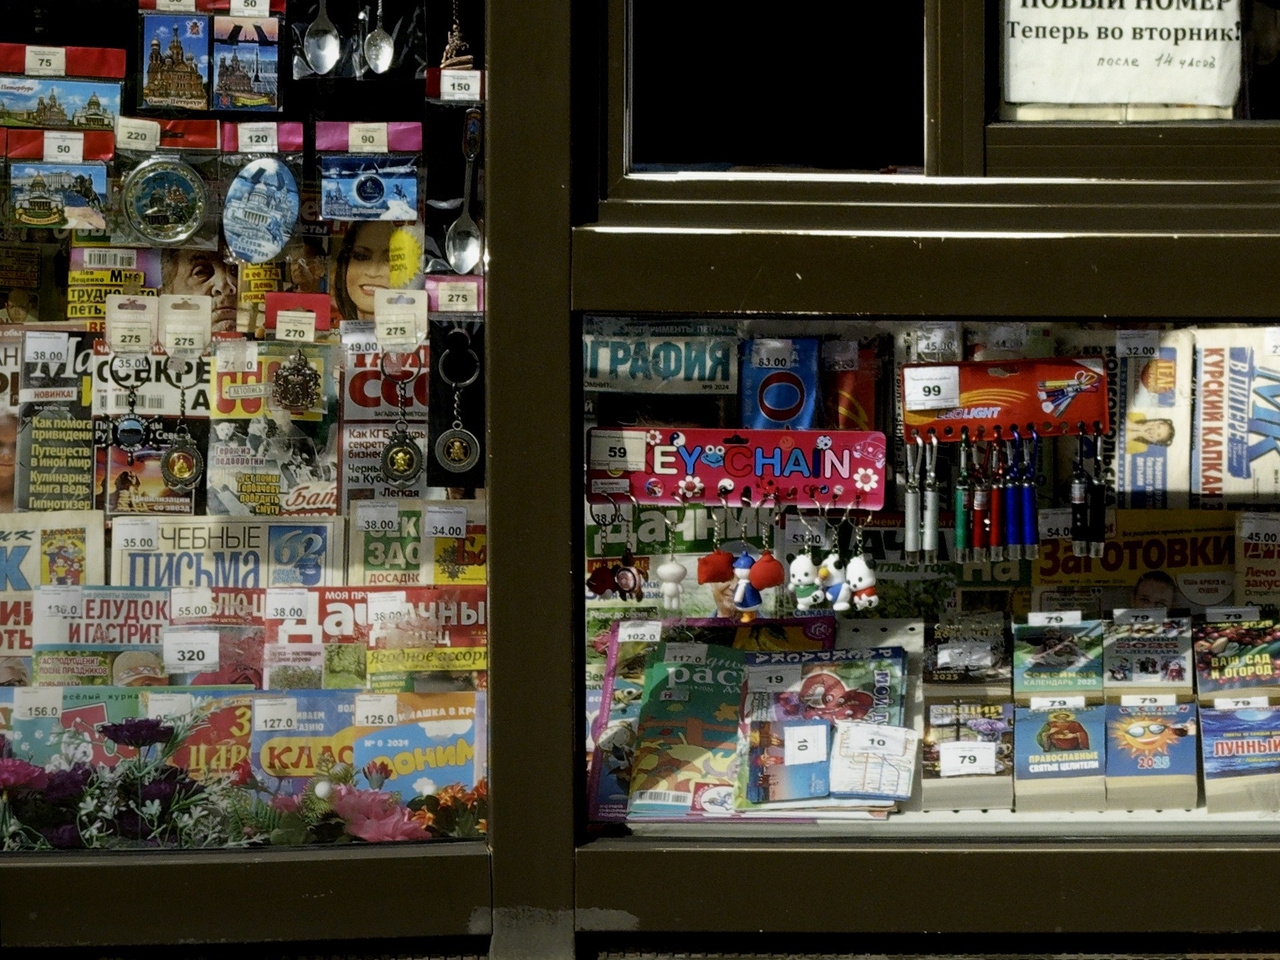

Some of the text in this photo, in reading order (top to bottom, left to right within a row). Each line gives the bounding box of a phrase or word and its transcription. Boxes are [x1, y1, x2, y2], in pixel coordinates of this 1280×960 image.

[1006, 21, 1242, 46] Теперь во вторник!
[38, 58, 52, 68] 75
[1096, 57, 1140, 68] после
[1154, 53, 1174, 68] 14
[450, 82, 471, 92] 150
[126, 131, 147, 141] 220
[247, 133, 268, 143] 120
[361, 135, 375, 144] 90
[56, 144, 71, 154] 50
[448, 294, 468, 303] 275
[284, 328, 305, 339] 270
[386, 326, 407, 336] 275
[120, 334, 141, 343] 275
[174, 337, 195, 346] 275
[33, 351, 63, 361] 38.00
[1126, 346, 1155, 356] 32.00
[34, 390, 74, 399] НОВИНКА!
[922, 385, 941, 397] 99
[32, 416, 92, 430] Как помога
[1202, 347, 1225, 498] КУРСКИЙ КАПКАН
[349, 428, 390, 440] Как КГБ
[608, 447, 627, 459] 59
[722, 444, 850, 479] CHAIN
[30, 483, 58, 494] книга
[364, 519, 394, 530] 38.00
[432, 526, 462, 537] 34.00
[123, 537, 153, 548] 35.00
[1245, 567, 1271, 578] Лечо
[178, 606, 208, 616] 55.00
[273, 607, 303, 617] 38.00
[1045, 615, 1064, 624] 79
[1131, 614, 1150, 622] 79
[83, 623, 163, 644] ГАСТРИТ
[177, 649, 205, 662] 320
[1210, 653, 1272, 666] ВАШ САД
[1210, 664, 1273, 681] И ОГОРОД
[766, 675, 784, 685] 19
[1022, 679, 1074, 687] КАЛЕНДАРЬ
[1048, 699, 1067, 708] 79
[1139, 697, 1158, 705] 79
[1232, 699, 1251, 707] 79
[27, 706, 58, 717] 156.0
[263, 717, 293, 728] 127.0
[364, 714, 394, 725] 125.0
[797, 738, 808, 751] 10
[868, 737, 886, 748] 10
[958, 755, 977, 765] 79
[1028, 751, 1099, 764] ПРАВОСЛАВНЫЕ
[1137, 755, 1170, 770] 2025
[1028, 760, 1100, 773] СВЯТЫЕ ЦЕЛИТЕЛИ
